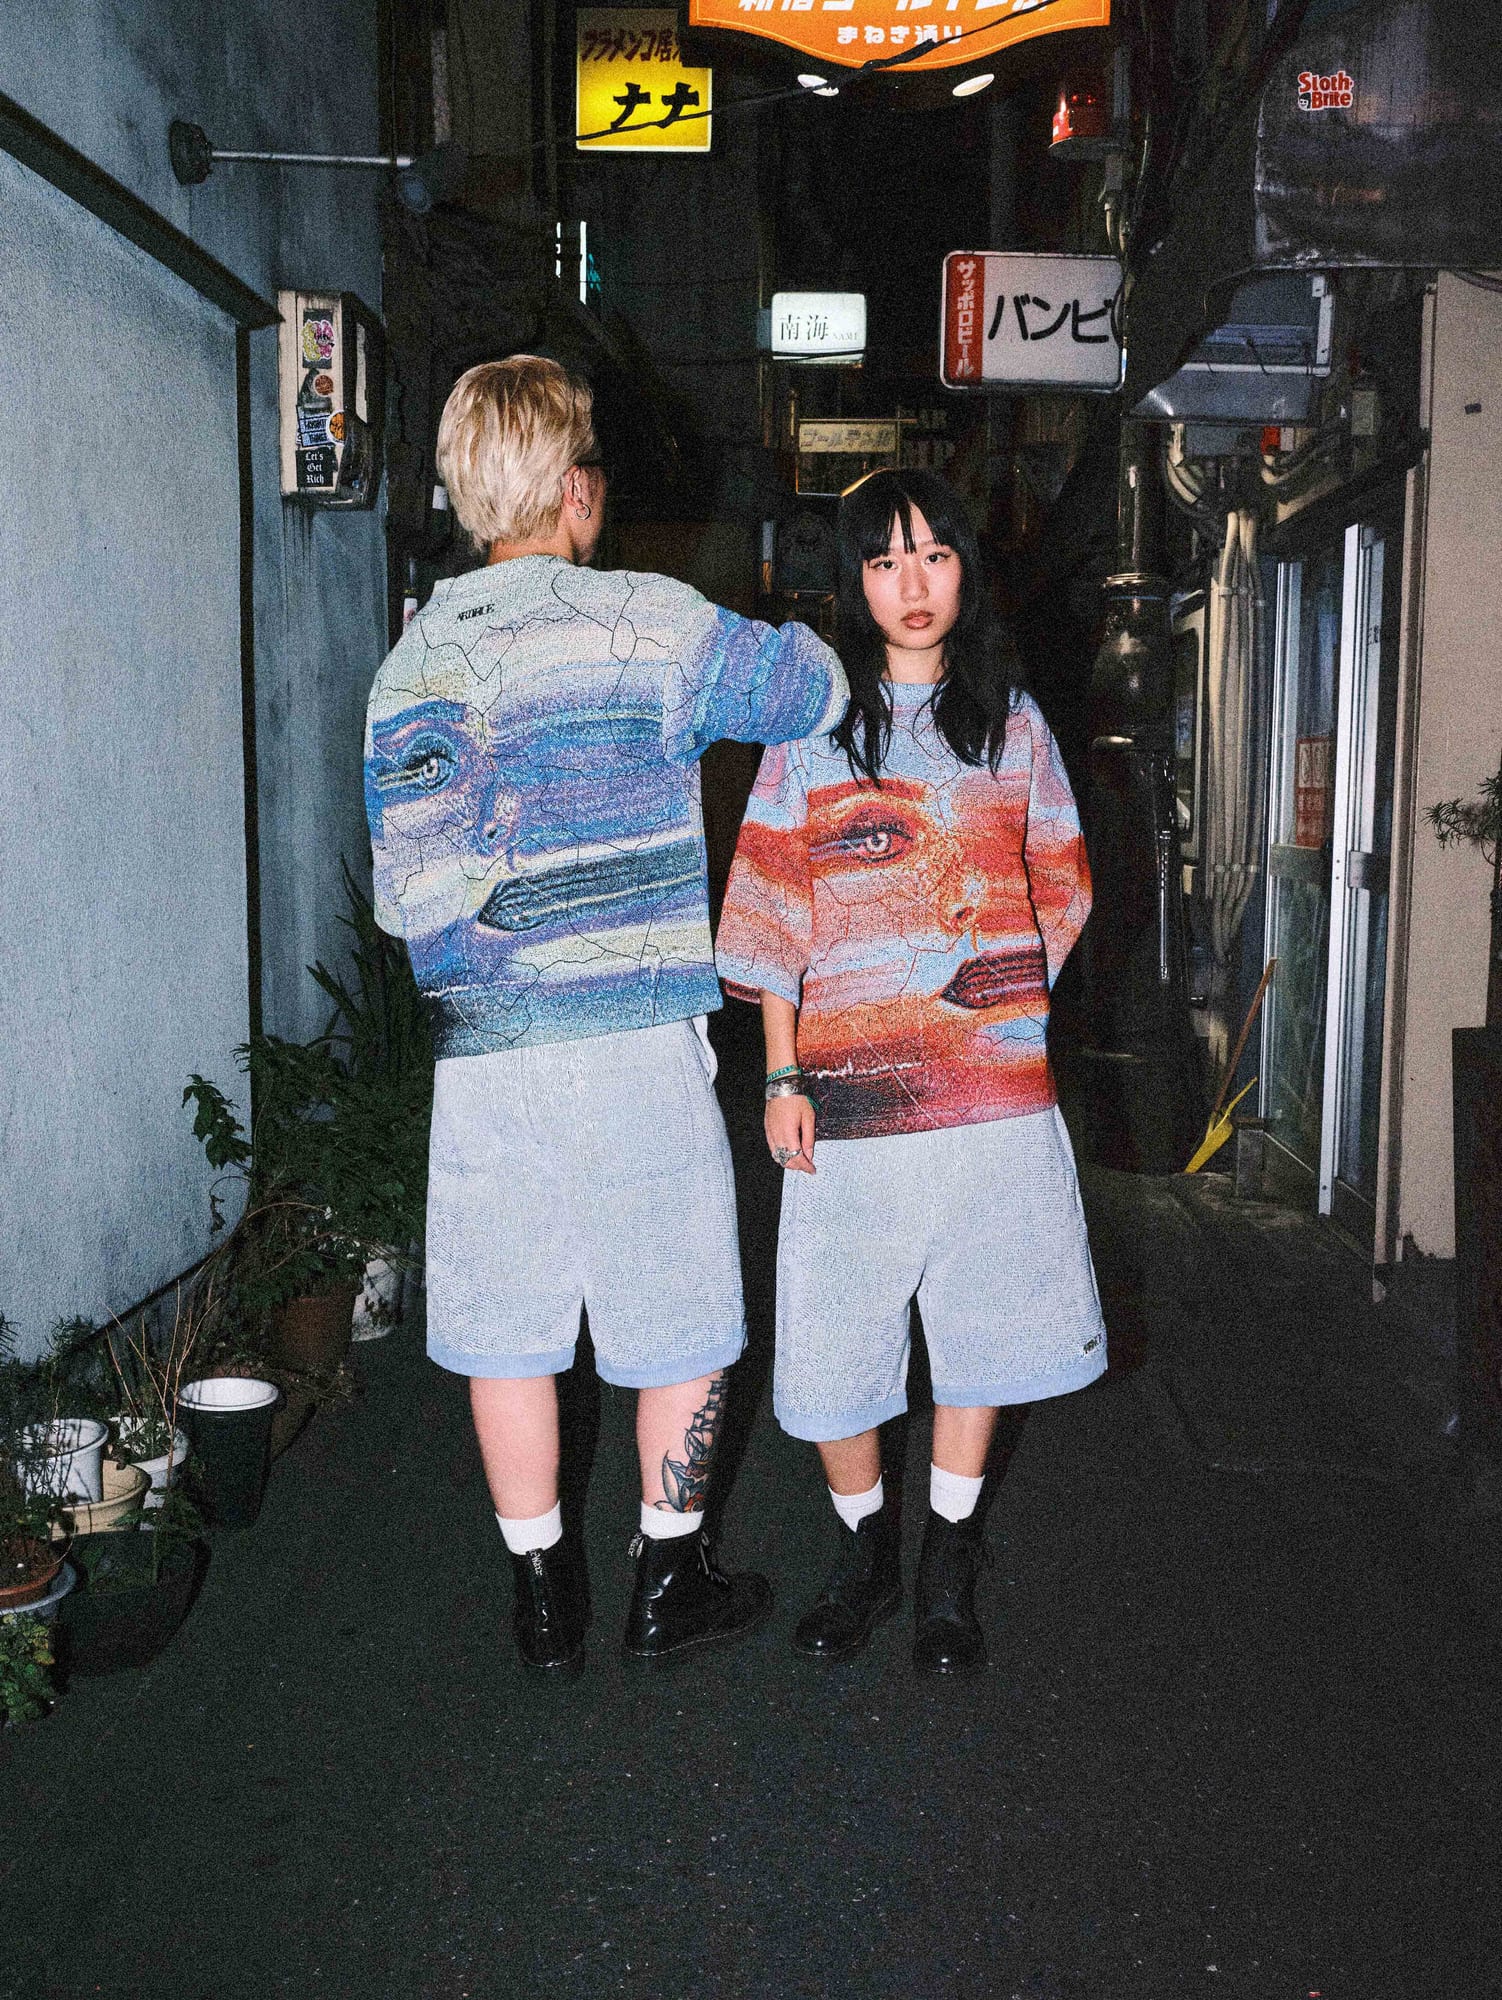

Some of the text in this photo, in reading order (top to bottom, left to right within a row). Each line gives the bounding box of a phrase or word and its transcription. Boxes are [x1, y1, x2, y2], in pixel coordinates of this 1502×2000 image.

[611, 82, 700, 130] ナナ
[1312, 92, 1351, 109] Brite
[780, 314, 829, 341] 南海
[956, 259, 976, 378] サッポロビール
[988, 293, 1112, 343] バンビ
[306, 452, 324, 461] Let's
[306, 463, 322, 472] Get
[306, 474, 325, 484] Rich
